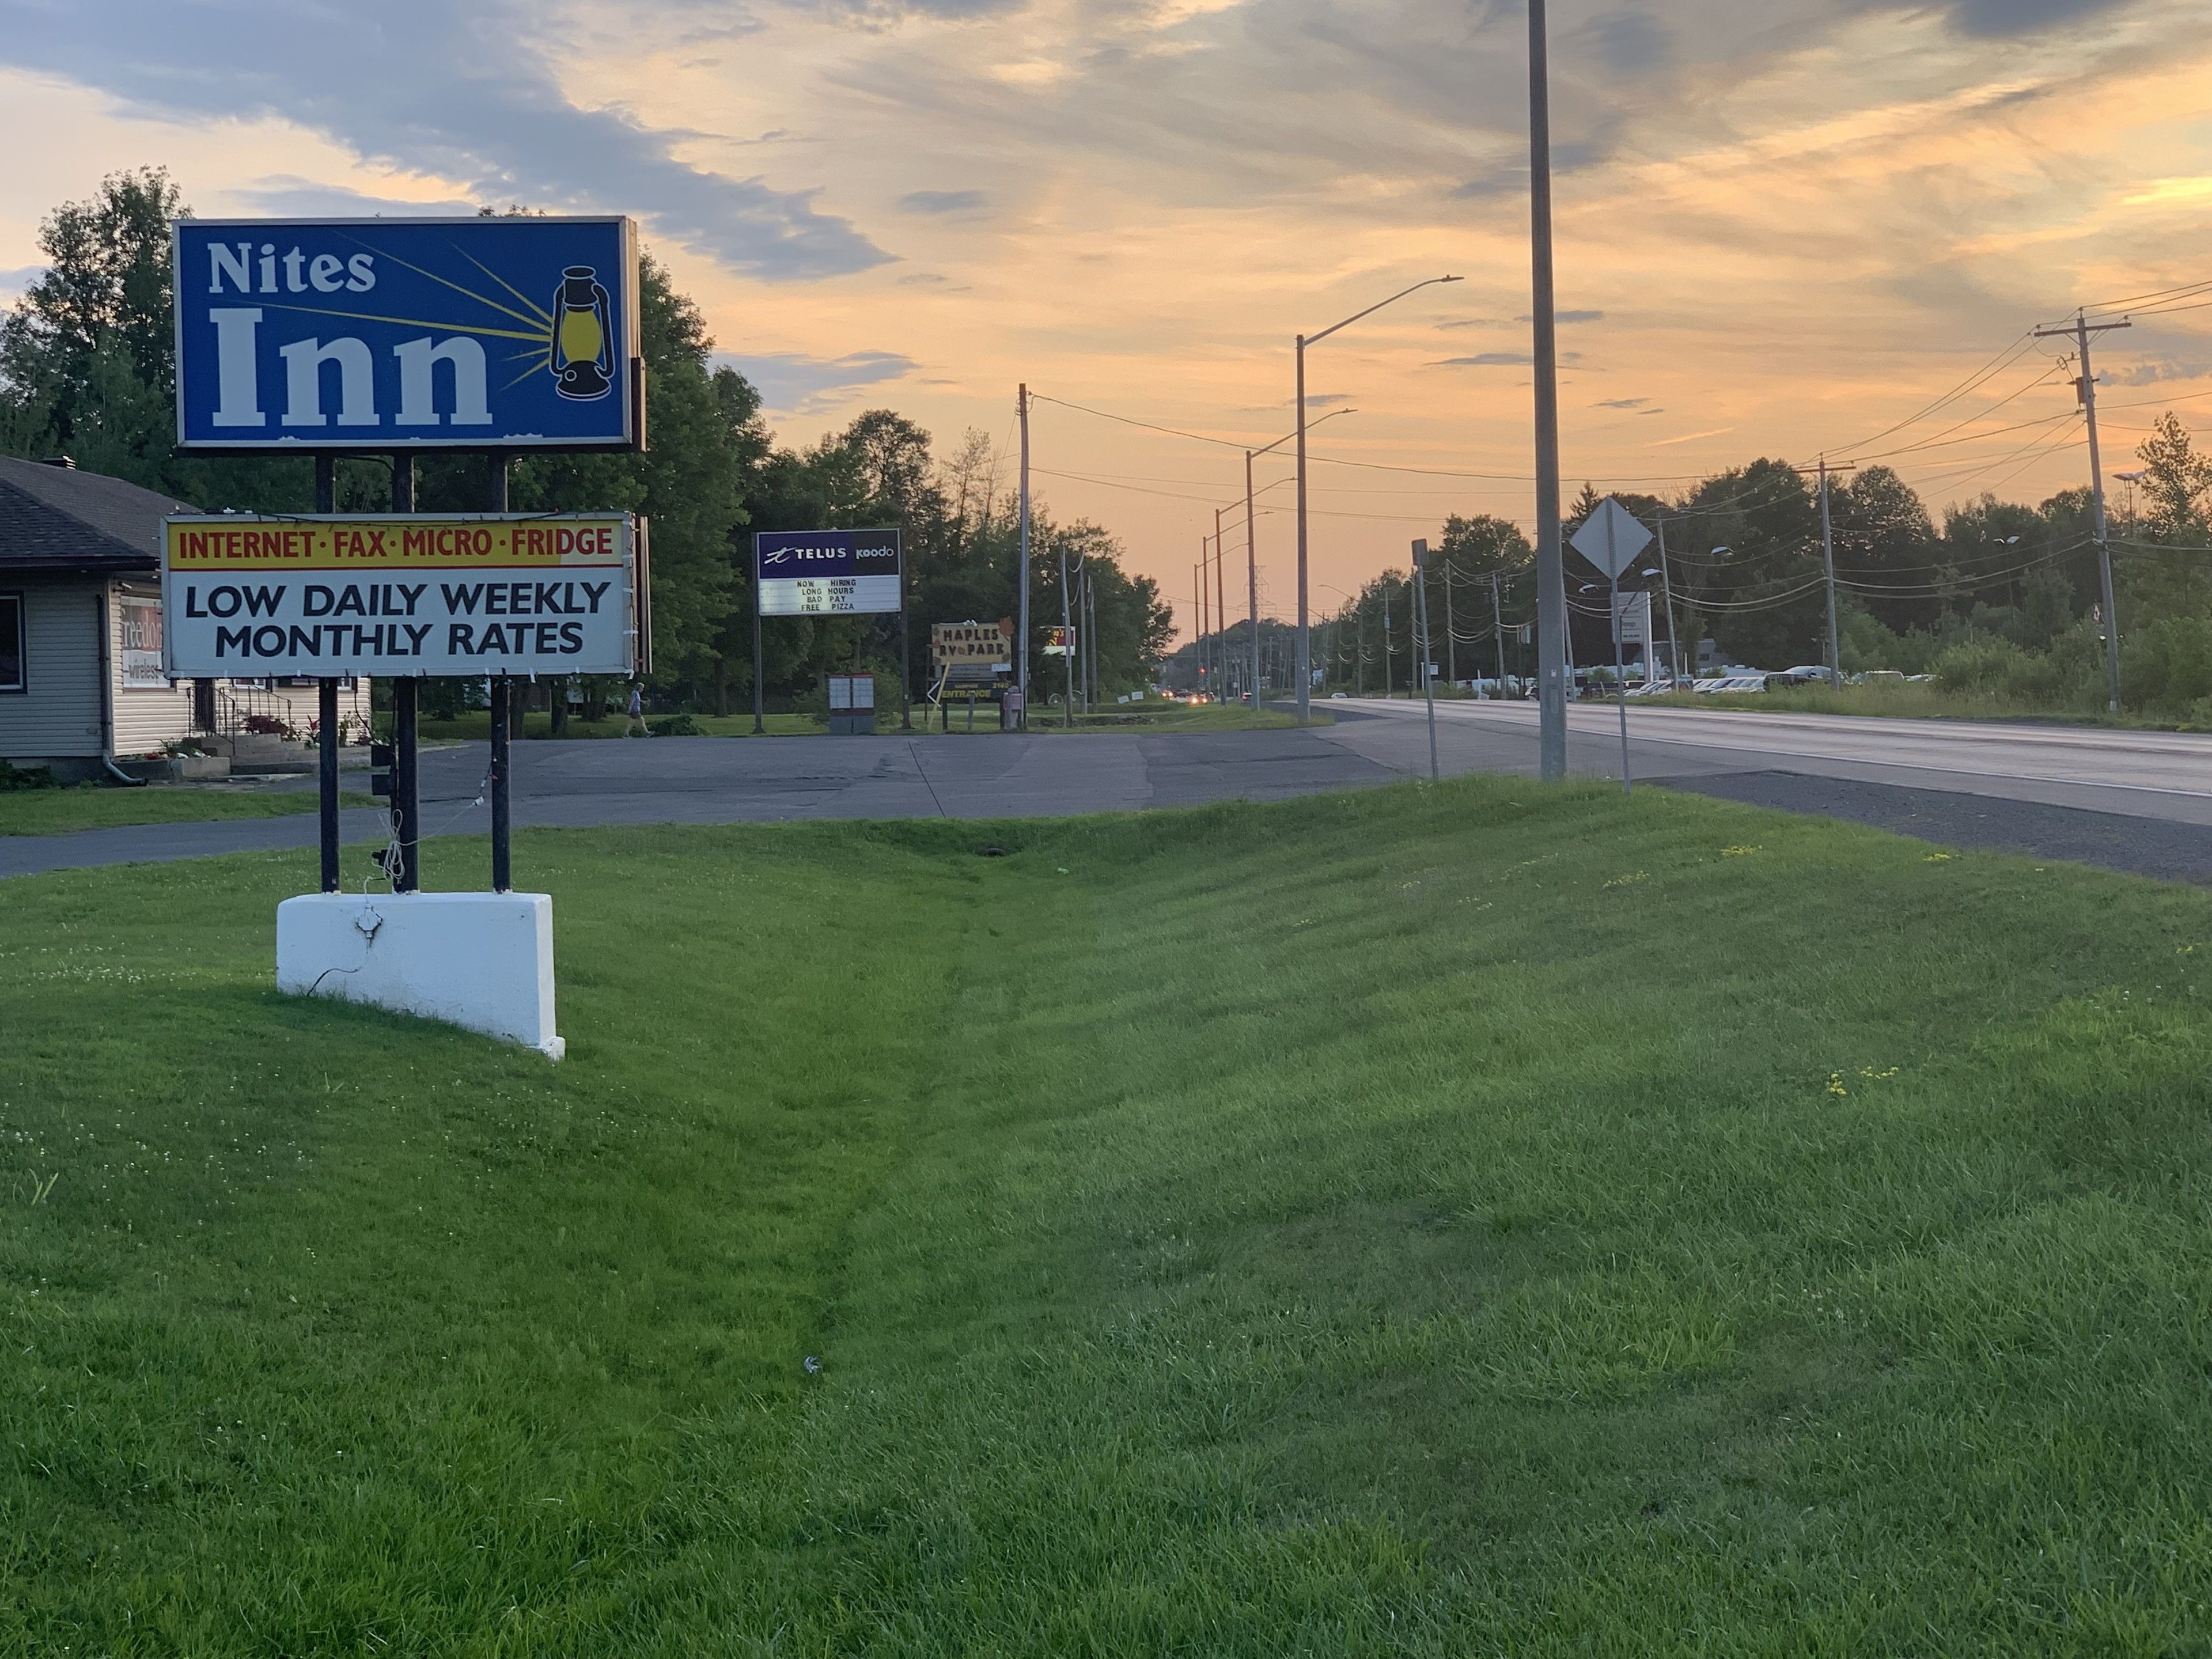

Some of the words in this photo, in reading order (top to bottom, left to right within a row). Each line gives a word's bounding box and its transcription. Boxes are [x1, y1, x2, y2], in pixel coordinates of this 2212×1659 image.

[207, 243, 376, 294] Nites
[209, 308, 494, 427] Inn
[179, 531, 317, 559] INTERNET
[334, 530, 388, 558] FAX
[403, 528, 493, 557] MICRO
[512, 527, 613, 556] FRIDGE
[795, 548, 847, 559] TELUS
[185, 585, 287, 618] LOW
[303, 584, 428, 618] DAILY
[441, 581, 612, 616] WEEKLY
[215, 623, 433, 658] MONTHLY
[448, 622, 584, 656] RATES
[940, 645, 957, 656] RV
[967, 643, 1004, 656] PARK
[943, 628, 999, 642] MAPLES
